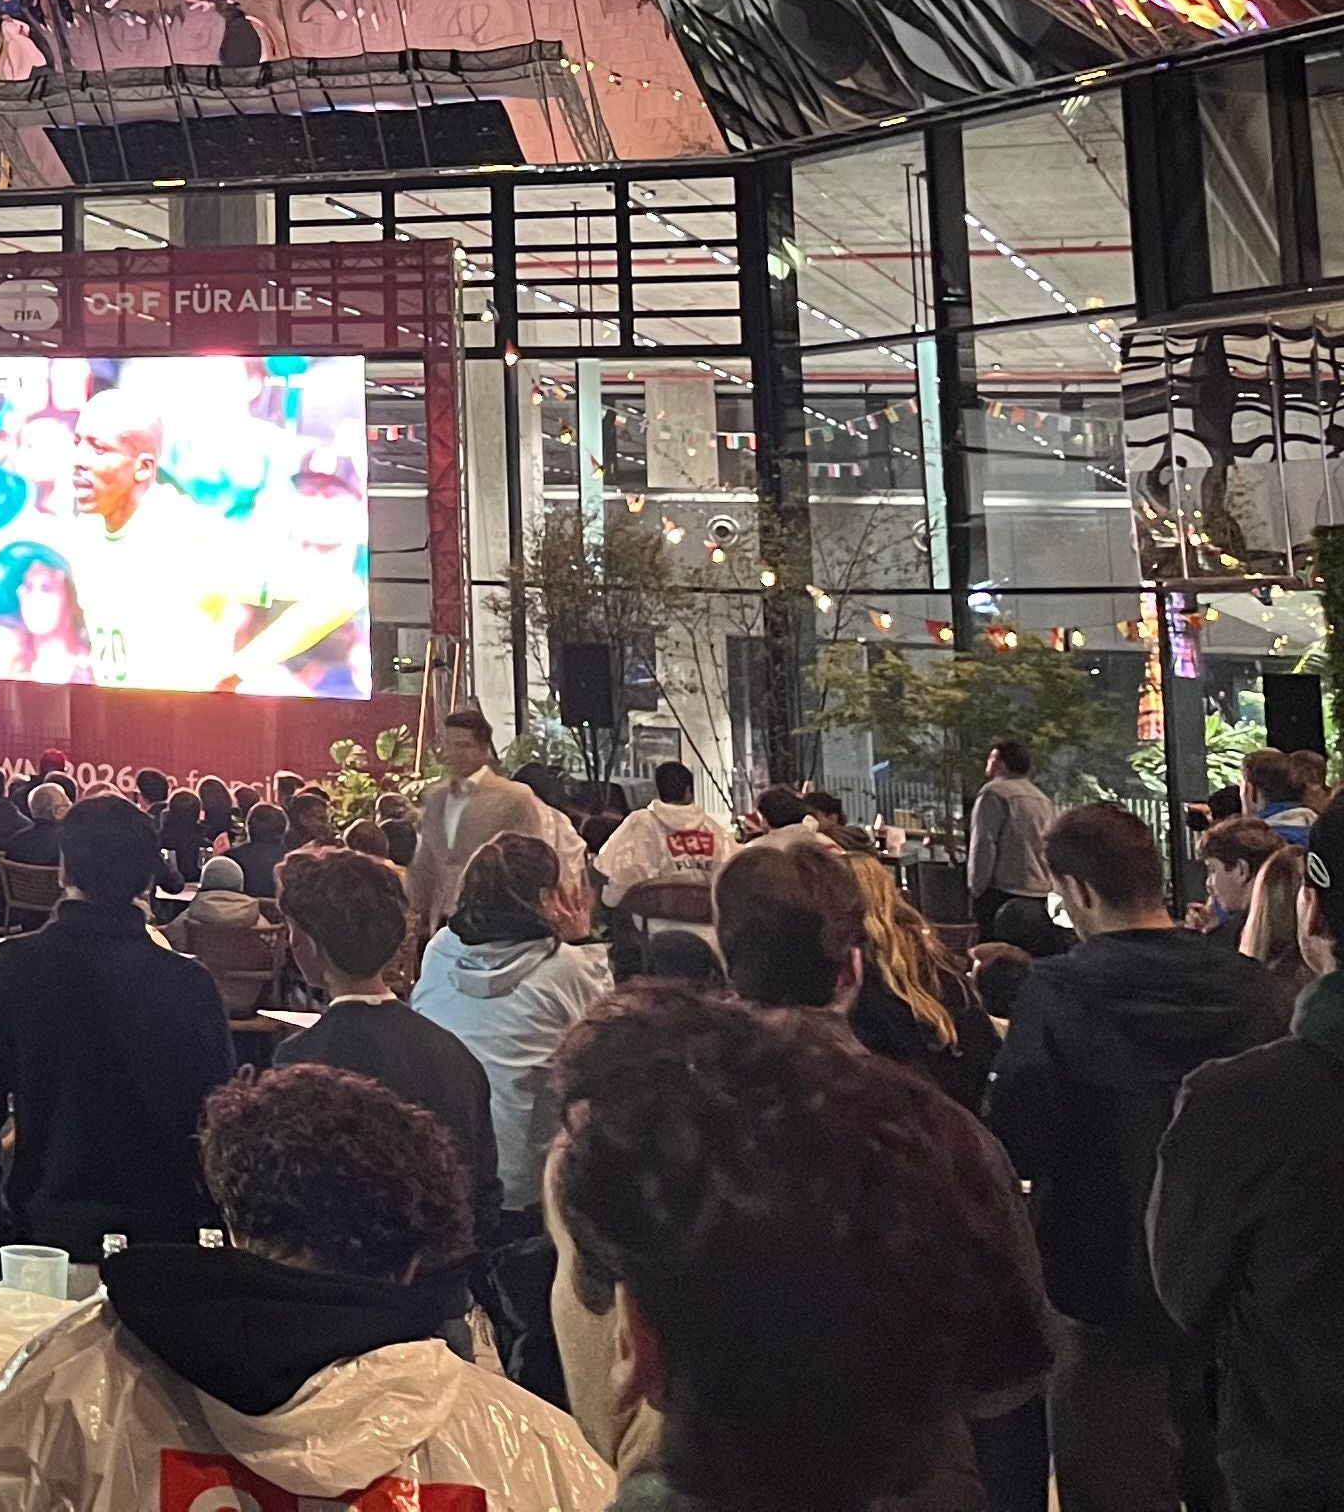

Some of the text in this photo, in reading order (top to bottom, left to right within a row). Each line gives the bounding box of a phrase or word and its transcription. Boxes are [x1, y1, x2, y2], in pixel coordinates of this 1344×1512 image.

[86, 283, 313, 317] ORF FÜR ALLE
[13, 308, 43, 322] FIFA
